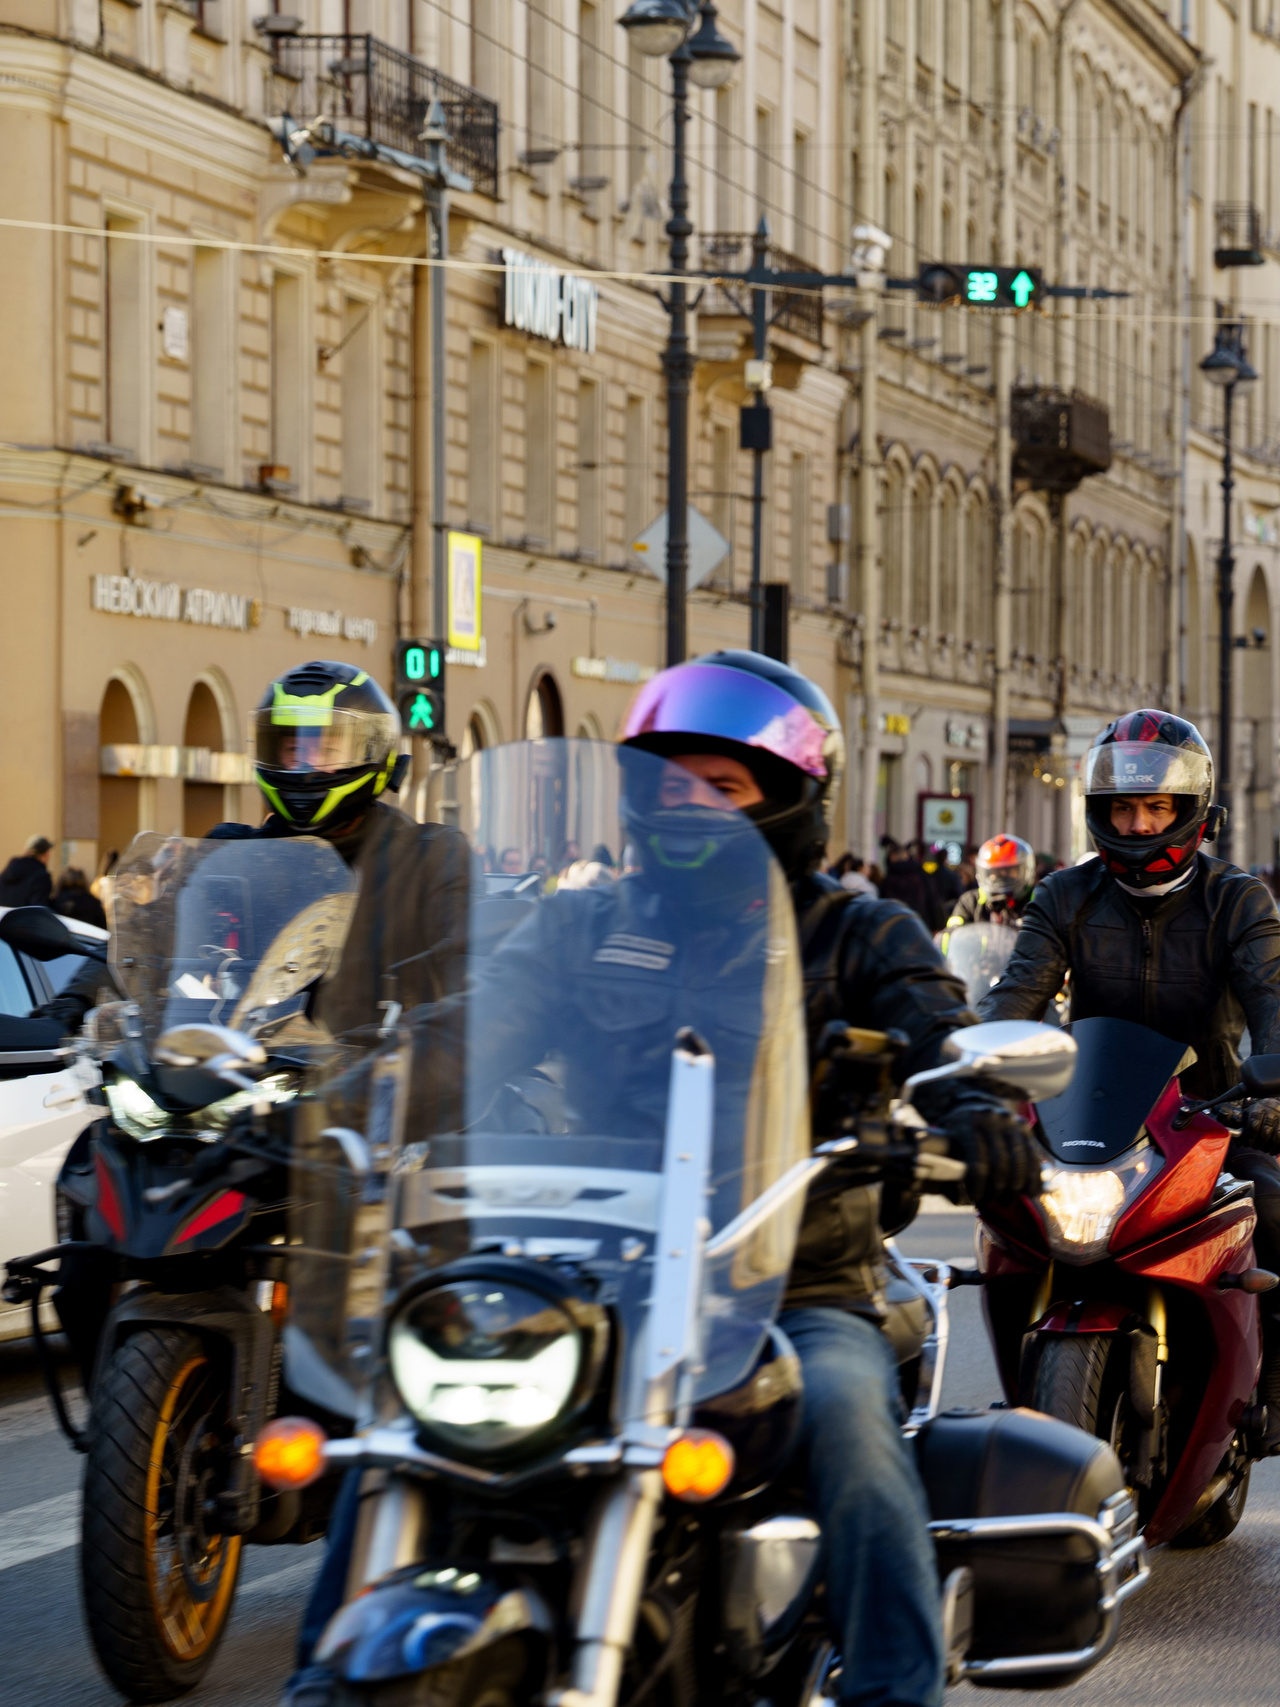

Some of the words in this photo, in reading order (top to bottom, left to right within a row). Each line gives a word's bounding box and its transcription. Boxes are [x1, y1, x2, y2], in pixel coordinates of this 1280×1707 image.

[967, 271, 998, 301] 32
[406, 647, 440, 679] 01
[1108, 774, 1155, 784] SHARK
[1061, 1139, 1106, 1149] HONDA
